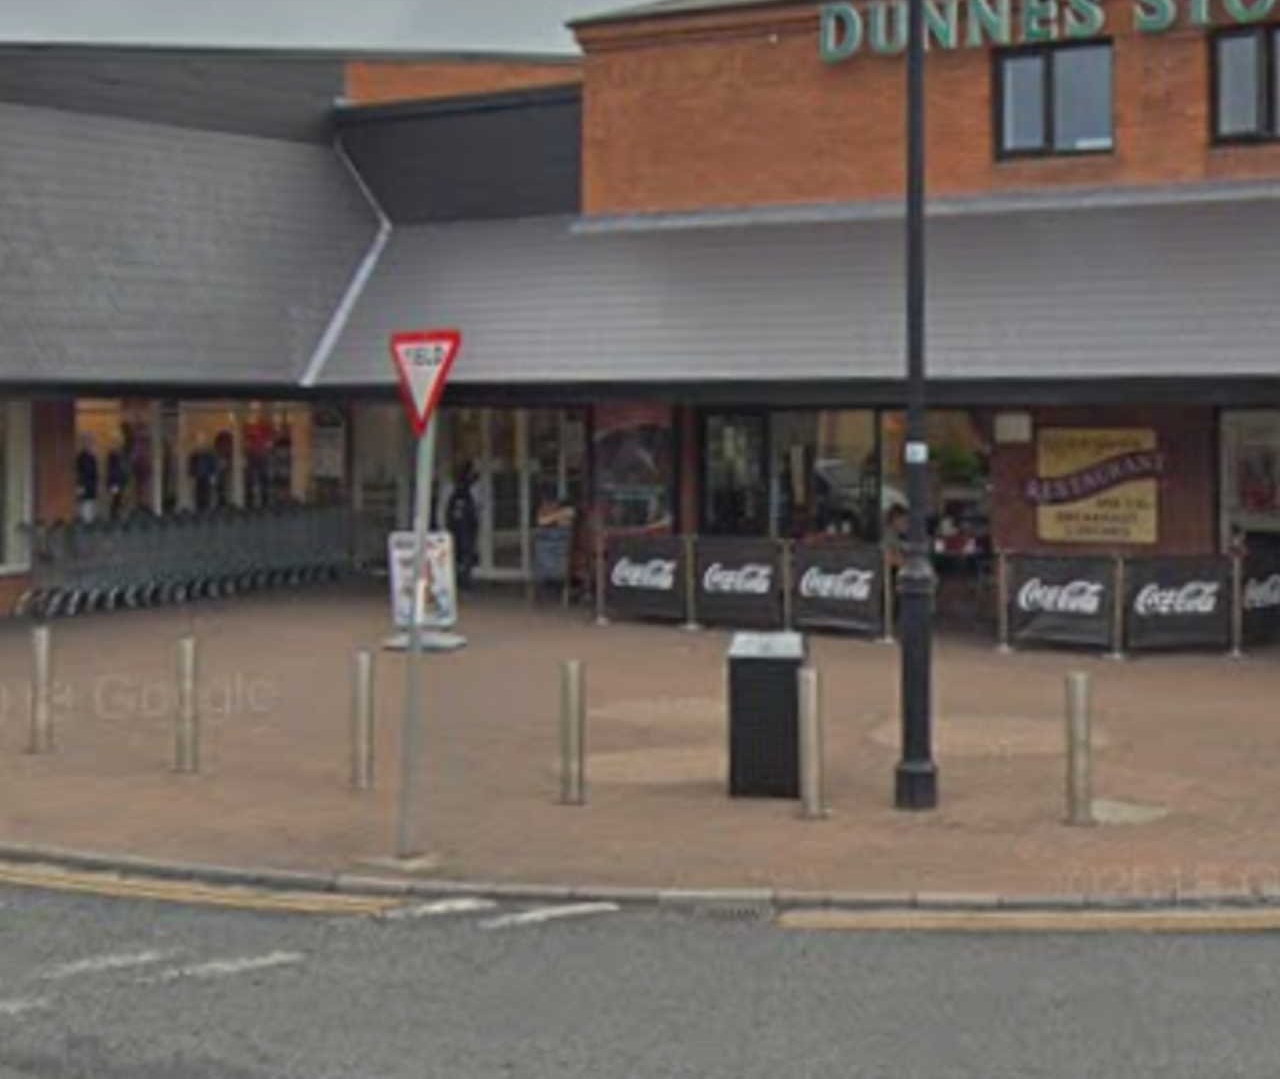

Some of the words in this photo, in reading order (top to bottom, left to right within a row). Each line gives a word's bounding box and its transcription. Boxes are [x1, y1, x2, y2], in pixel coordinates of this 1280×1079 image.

[1024, 452, 1165, 503] RESTAURANT
[611, 558, 676, 590] Coca-Cola
[702, 563, 772, 594] Coca-Cola
[800, 567, 874, 600] Coca-Cola
[1017, 577, 1104, 614] Coca-Cola
[1134, 582, 1220, 615] Coca-Cola
